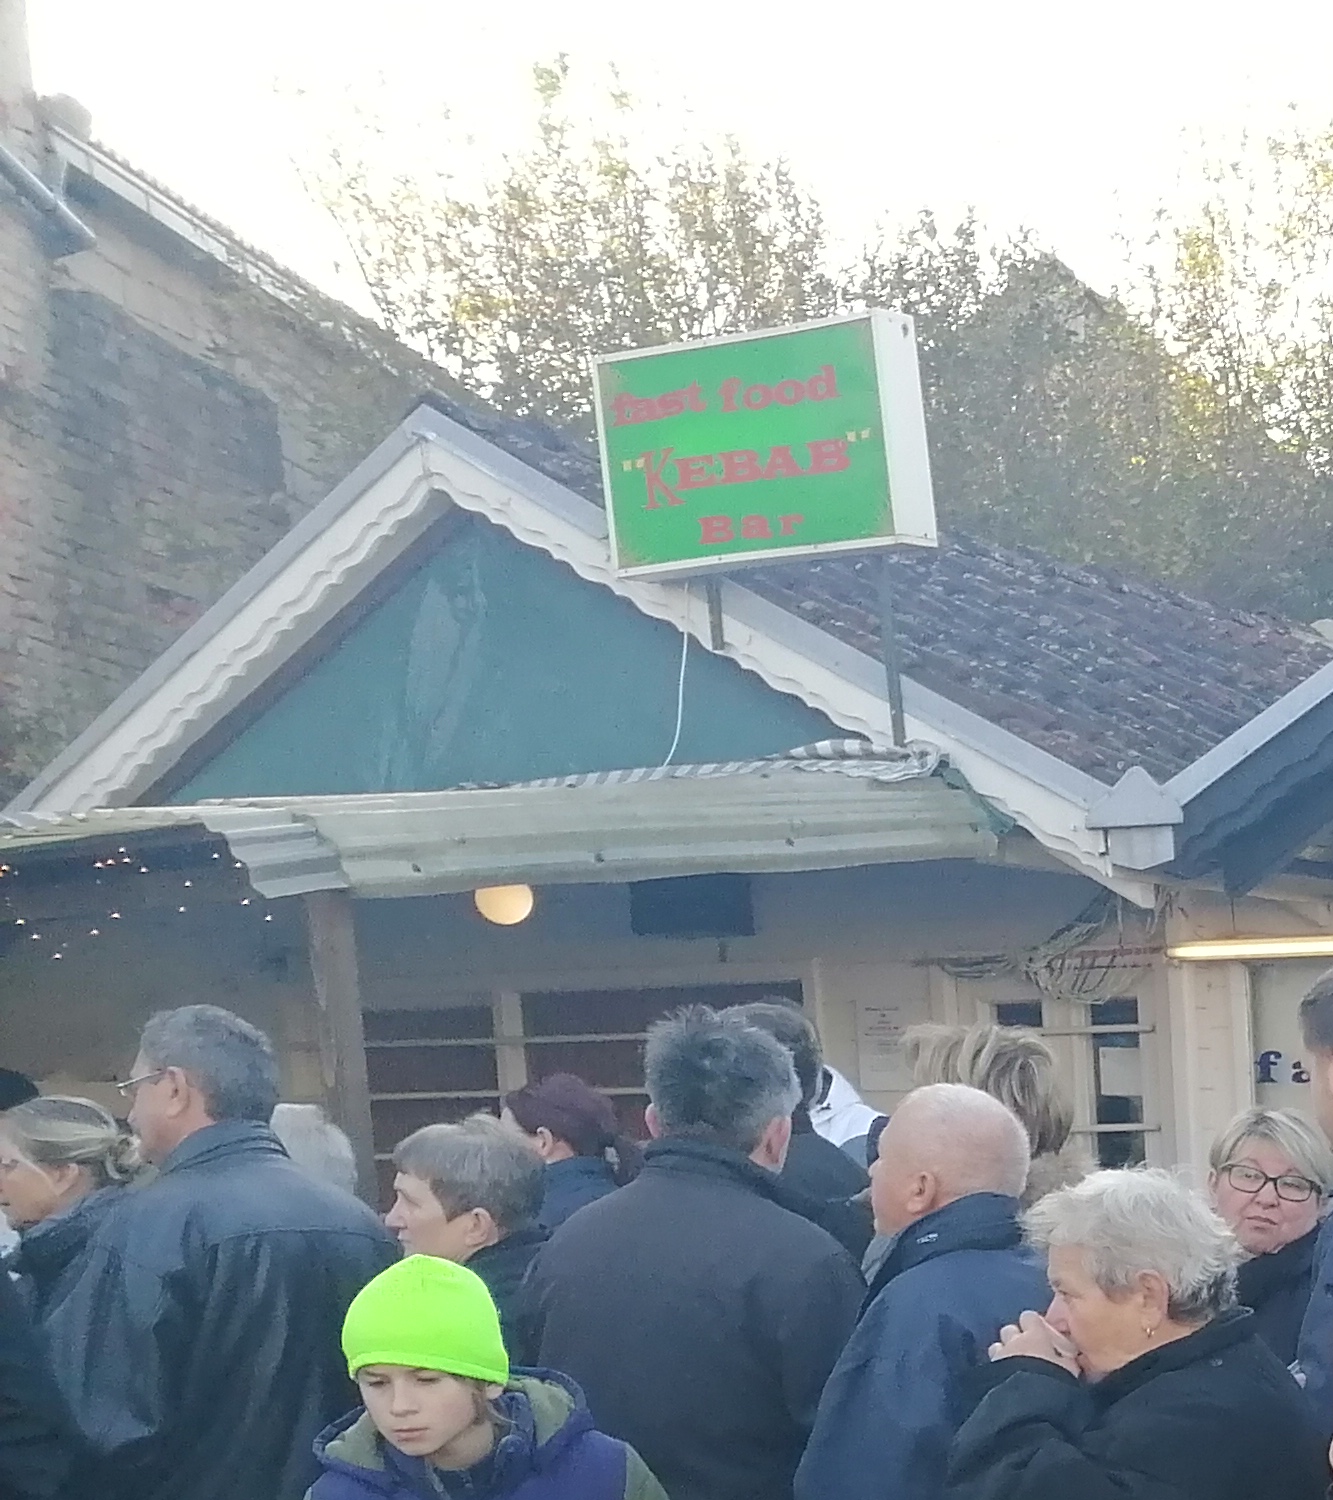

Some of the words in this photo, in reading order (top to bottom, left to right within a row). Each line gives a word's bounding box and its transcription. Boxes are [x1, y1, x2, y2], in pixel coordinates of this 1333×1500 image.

[610, 380, 707, 427] fast
[719, 364, 840, 413] food
[698, 515, 803, 544] Bar
